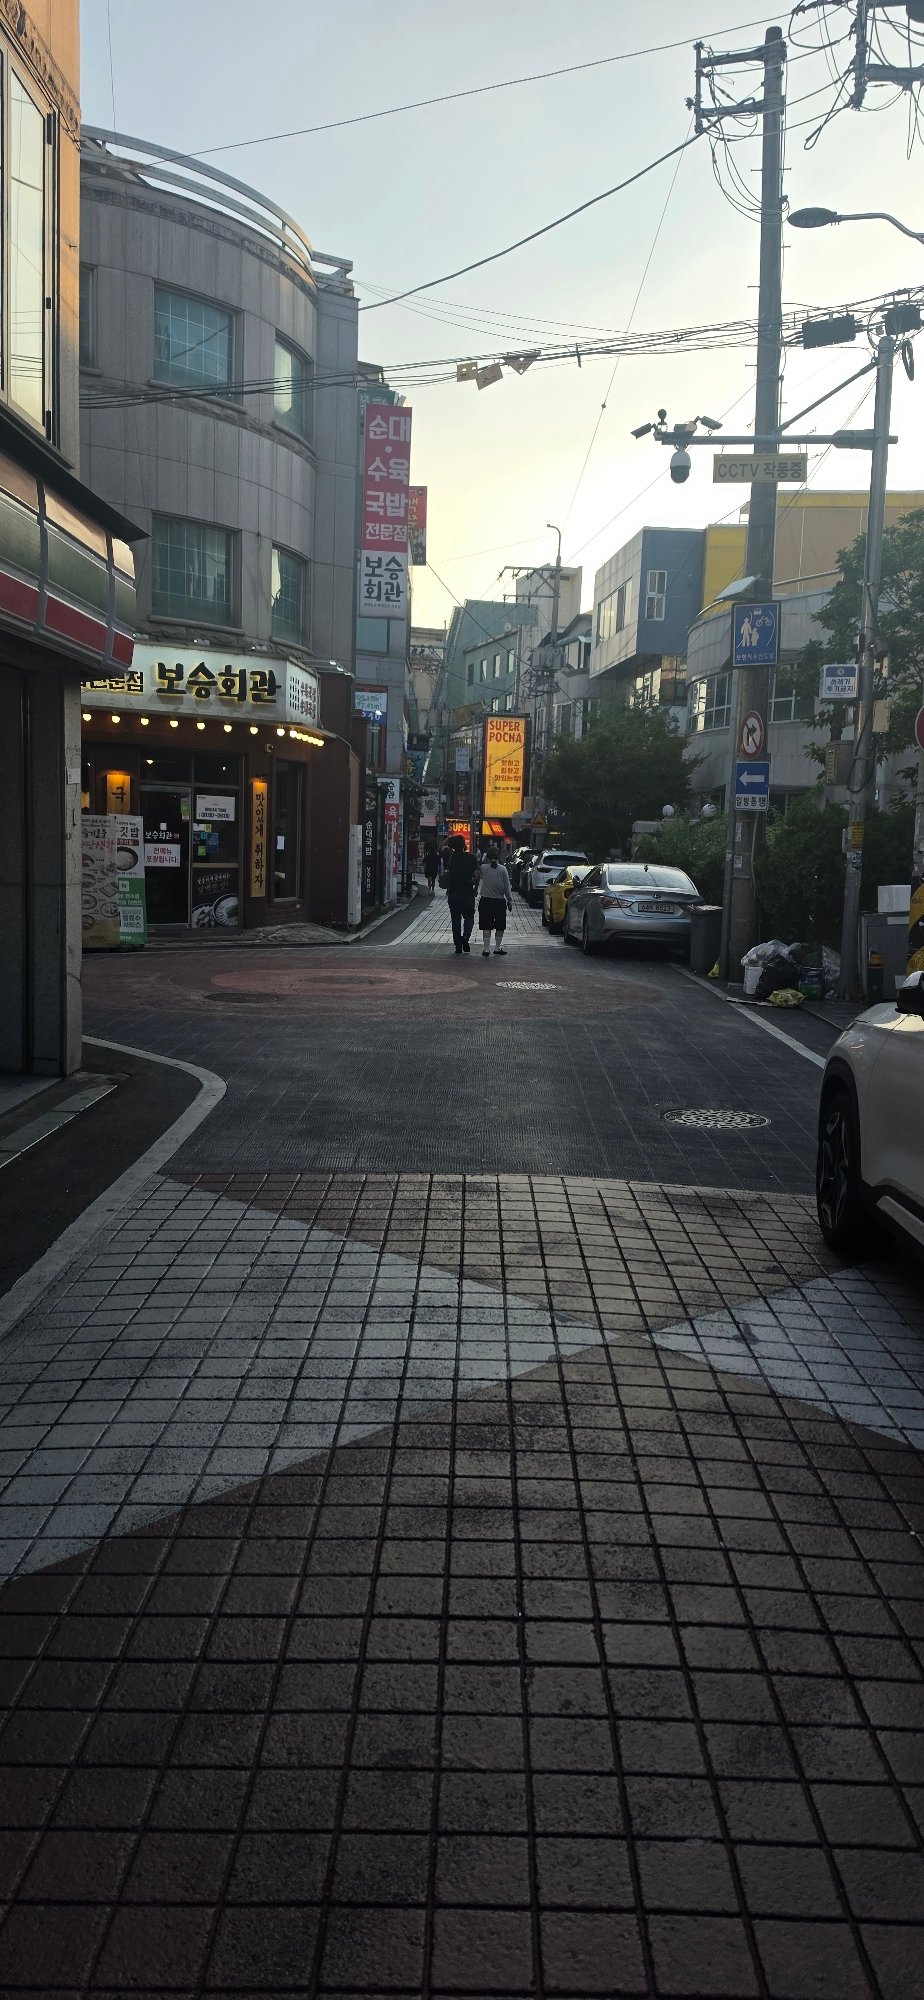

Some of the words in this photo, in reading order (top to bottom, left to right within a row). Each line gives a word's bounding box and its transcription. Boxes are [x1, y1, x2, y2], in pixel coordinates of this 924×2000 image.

[368, 414, 410, 442] 순대
[367, 456, 409, 486] 수육
[718, 463, 760, 478] CCTV
[763, 461, 803, 479] 작동중
[365, 490, 408, 518] 국밥
[365, 522, 408, 543] 전문점
[364, 555, 404, 581] 보승
[364, 578, 405, 603] 회관
[156, 661, 282, 703] 보승회관
[489, 720, 521, 732] SUPER
[488, 732, 522, 743] POCHA
[111, 786, 127, 804] 국
[736, 796, 767, 808] 일방통행
[117, 827, 140, 838] 깃밥
[145, 830, 174, 840] 보승회관
[365, 820, 374, 856] 순대국밥
[153, 847, 173, 855] 전메뉴
[254, 842, 265, 889] 취하자
